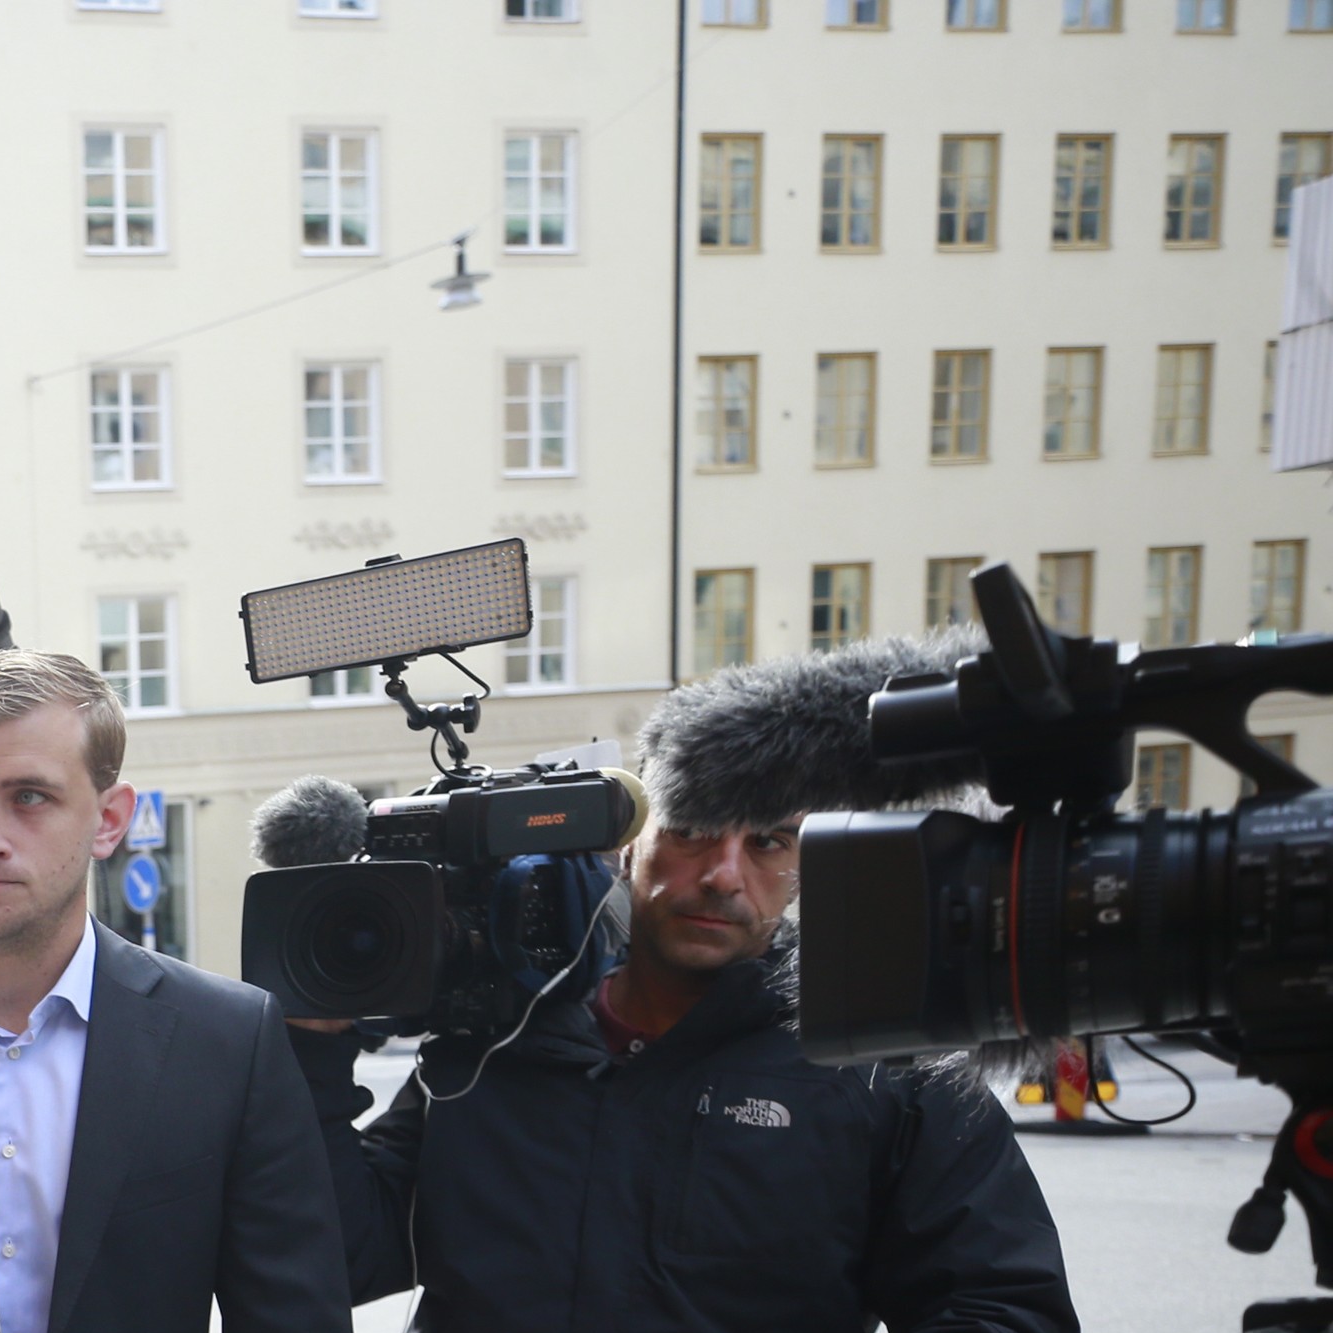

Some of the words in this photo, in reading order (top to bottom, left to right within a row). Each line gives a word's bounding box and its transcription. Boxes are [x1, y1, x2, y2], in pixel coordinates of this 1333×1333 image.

[745, 1097, 770, 1108] THE
[724, 1106, 770, 1117] NORTH
[735, 1115, 766, 1126] FACE
